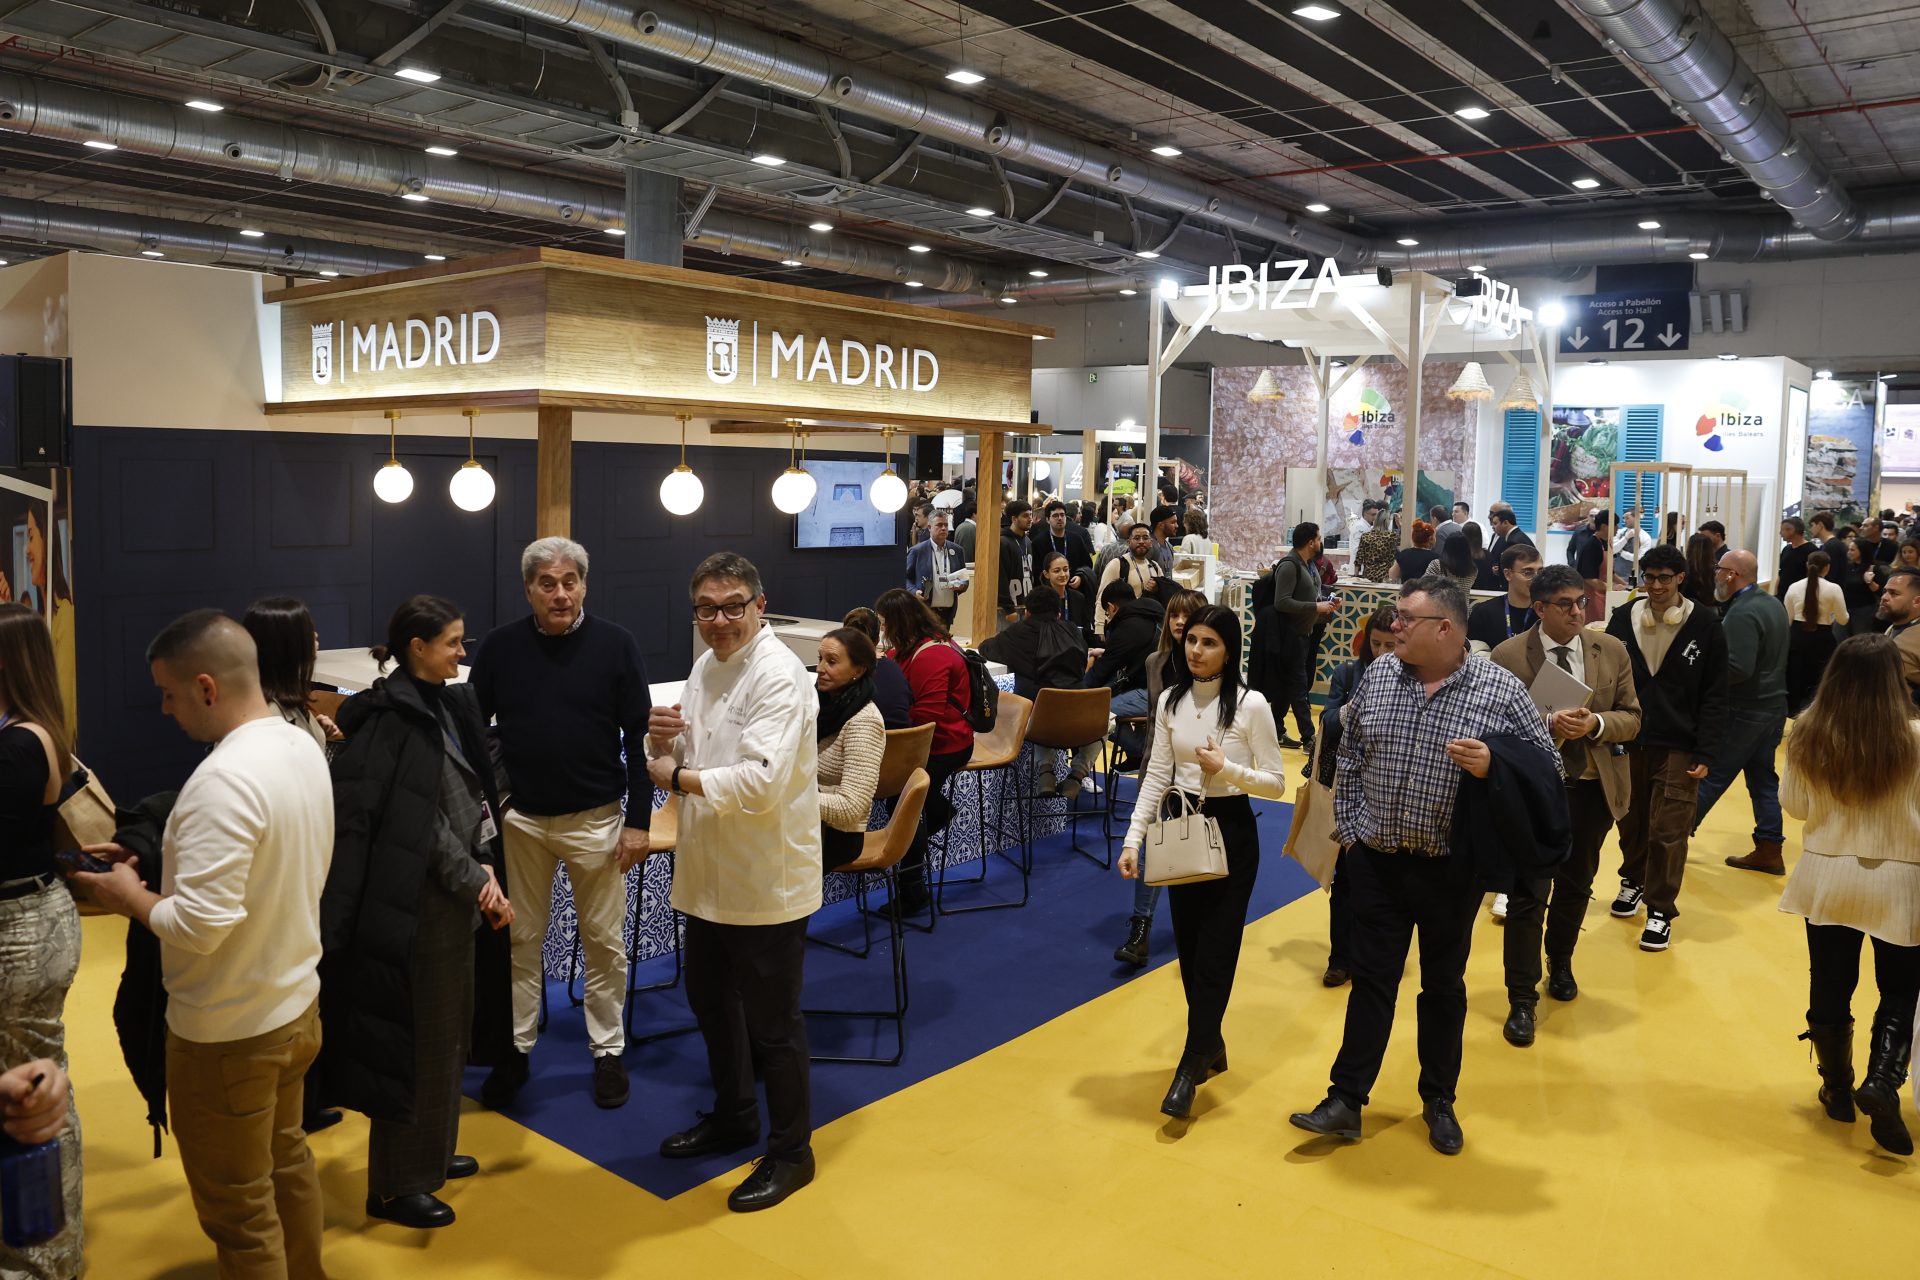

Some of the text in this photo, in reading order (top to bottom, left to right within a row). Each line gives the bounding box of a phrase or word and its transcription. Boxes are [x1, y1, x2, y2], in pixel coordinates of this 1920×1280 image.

[1208, 257, 1348, 313] IBIZA
[1598, 308, 1623, 316] Access
[1636, 306, 1652, 314] Hall
[1626, 298, 1662, 307] Pabellón
[352, 311, 501, 373] MADRID
[1602, 317, 1645, 349] 12
[771, 331, 940, 392] MADRID
[1362, 410, 1396, 423] Ibiza
[1721, 412, 1763, 426] Ibiza
